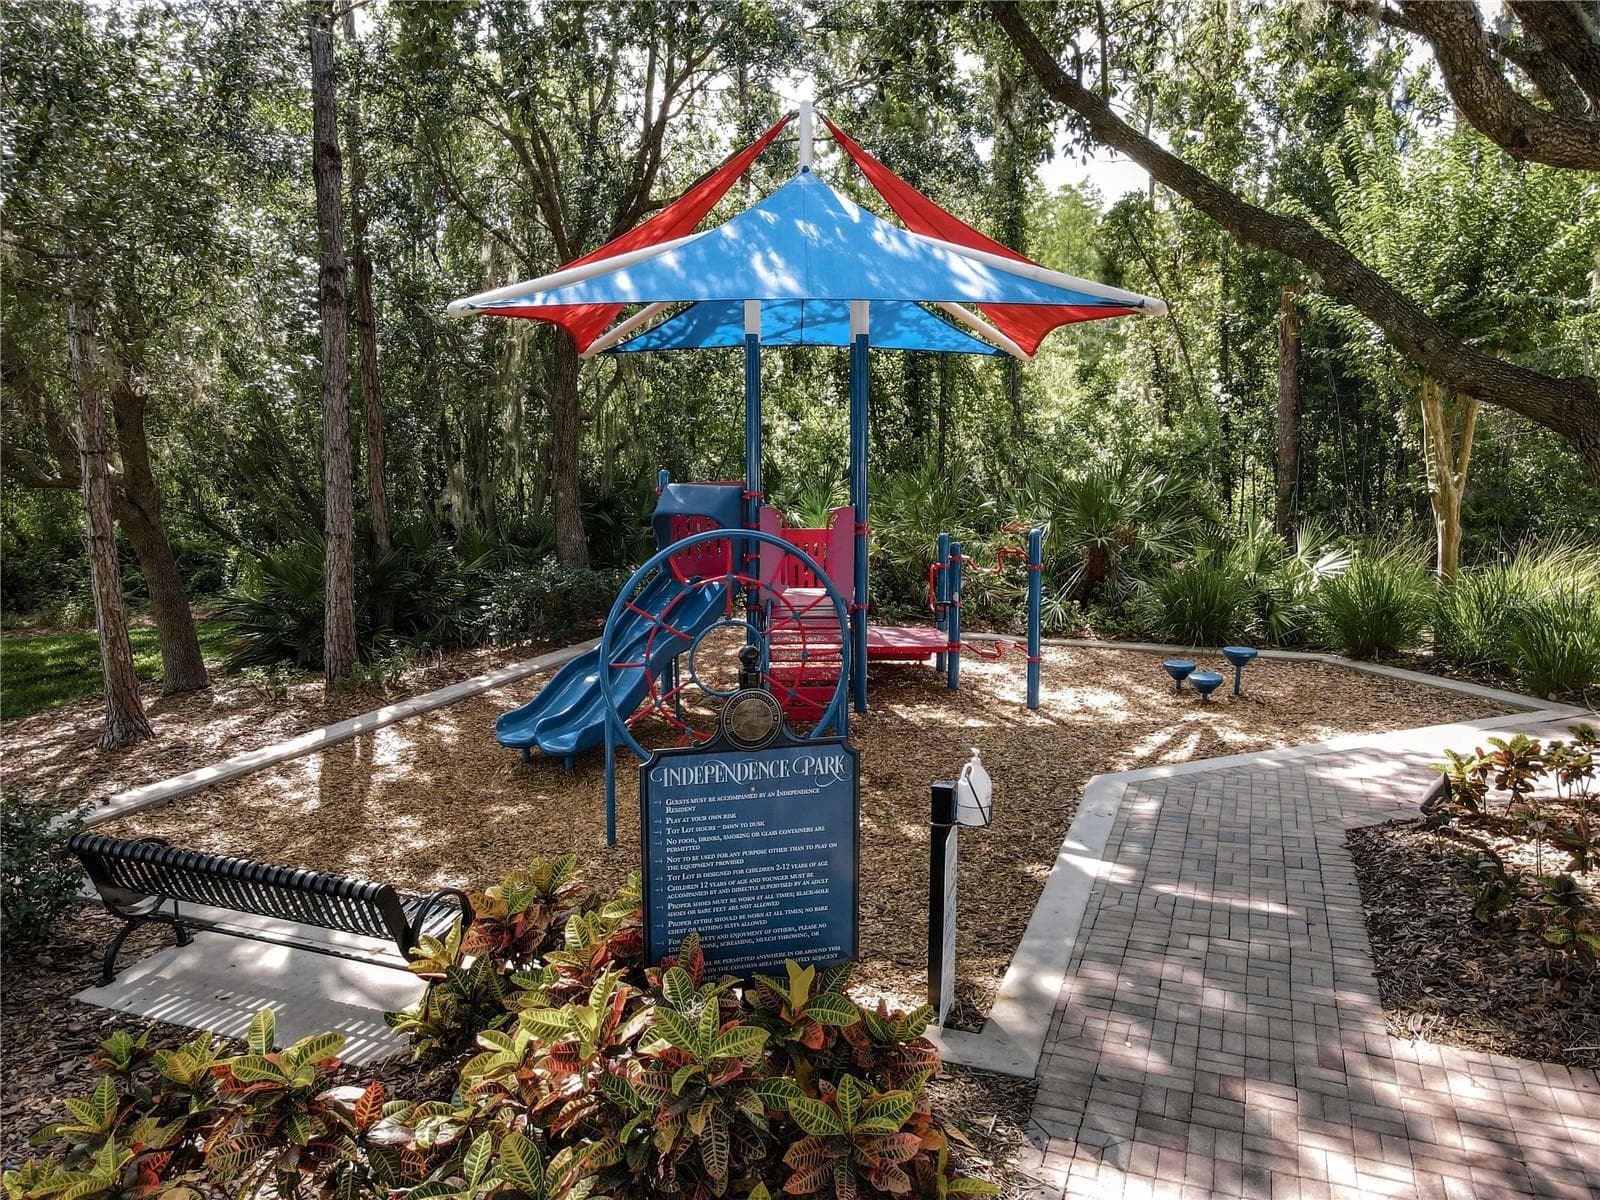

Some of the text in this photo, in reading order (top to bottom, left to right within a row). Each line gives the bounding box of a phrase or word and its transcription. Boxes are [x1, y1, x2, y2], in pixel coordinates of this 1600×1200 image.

[650, 754, 852, 787] INDEPENDENCE PARK
[776, 788, 820, 797] INDEPENDENCE
[666, 845, 700, 853] PERMITTED
[680, 862, 714, 870] EQUIPMENT
[667, 883, 698, 892] CHILDREN
[667, 891, 709, 899] ACCOMPANIED
[796, 888, 829, 896] BLACK-SOLE
[730, 930, 763, 938] ENJOYMENT
[720, 938, 754, 946] SCREAMING,
[756, 952, 786, 960] ANYWHERE
